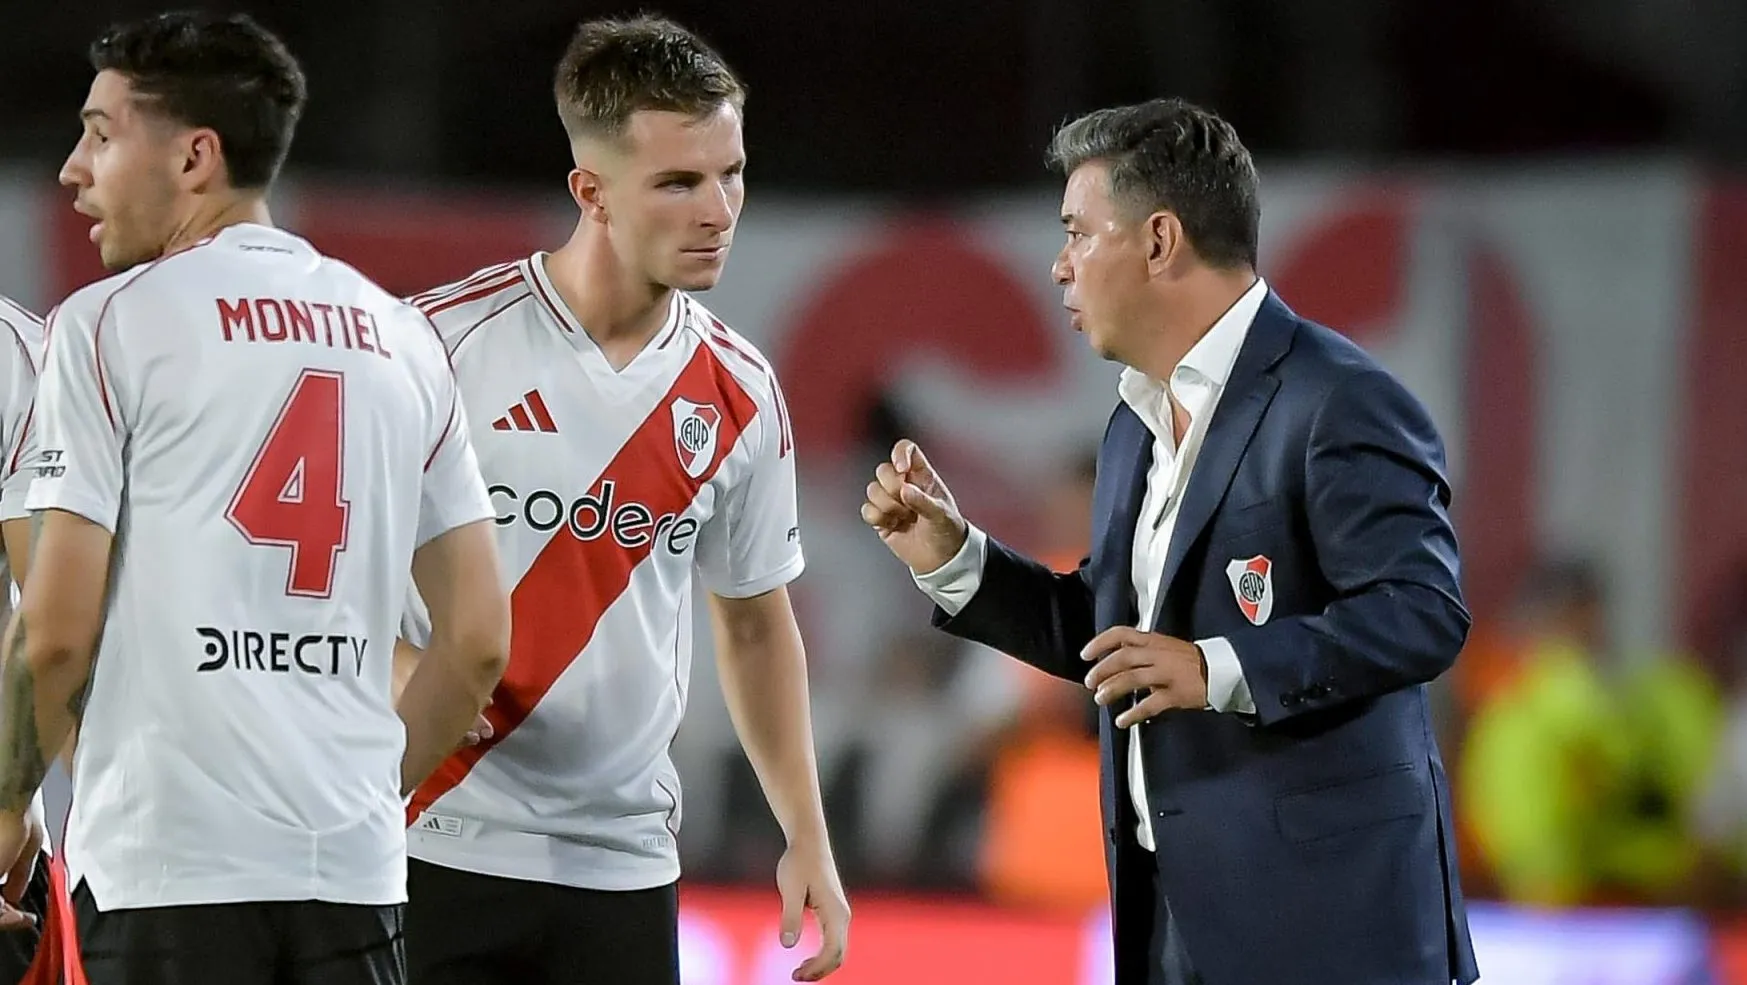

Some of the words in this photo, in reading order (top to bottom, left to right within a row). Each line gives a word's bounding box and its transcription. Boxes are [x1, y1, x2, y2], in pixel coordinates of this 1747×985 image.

[216, 298, 391, 359] MONTIEL
[680, 416, 709, 452] CARP
[225, 369, 350, 599] 4
[488, 480, 698, 555] codere
[195, 627, 368, 677] DIRECTV
